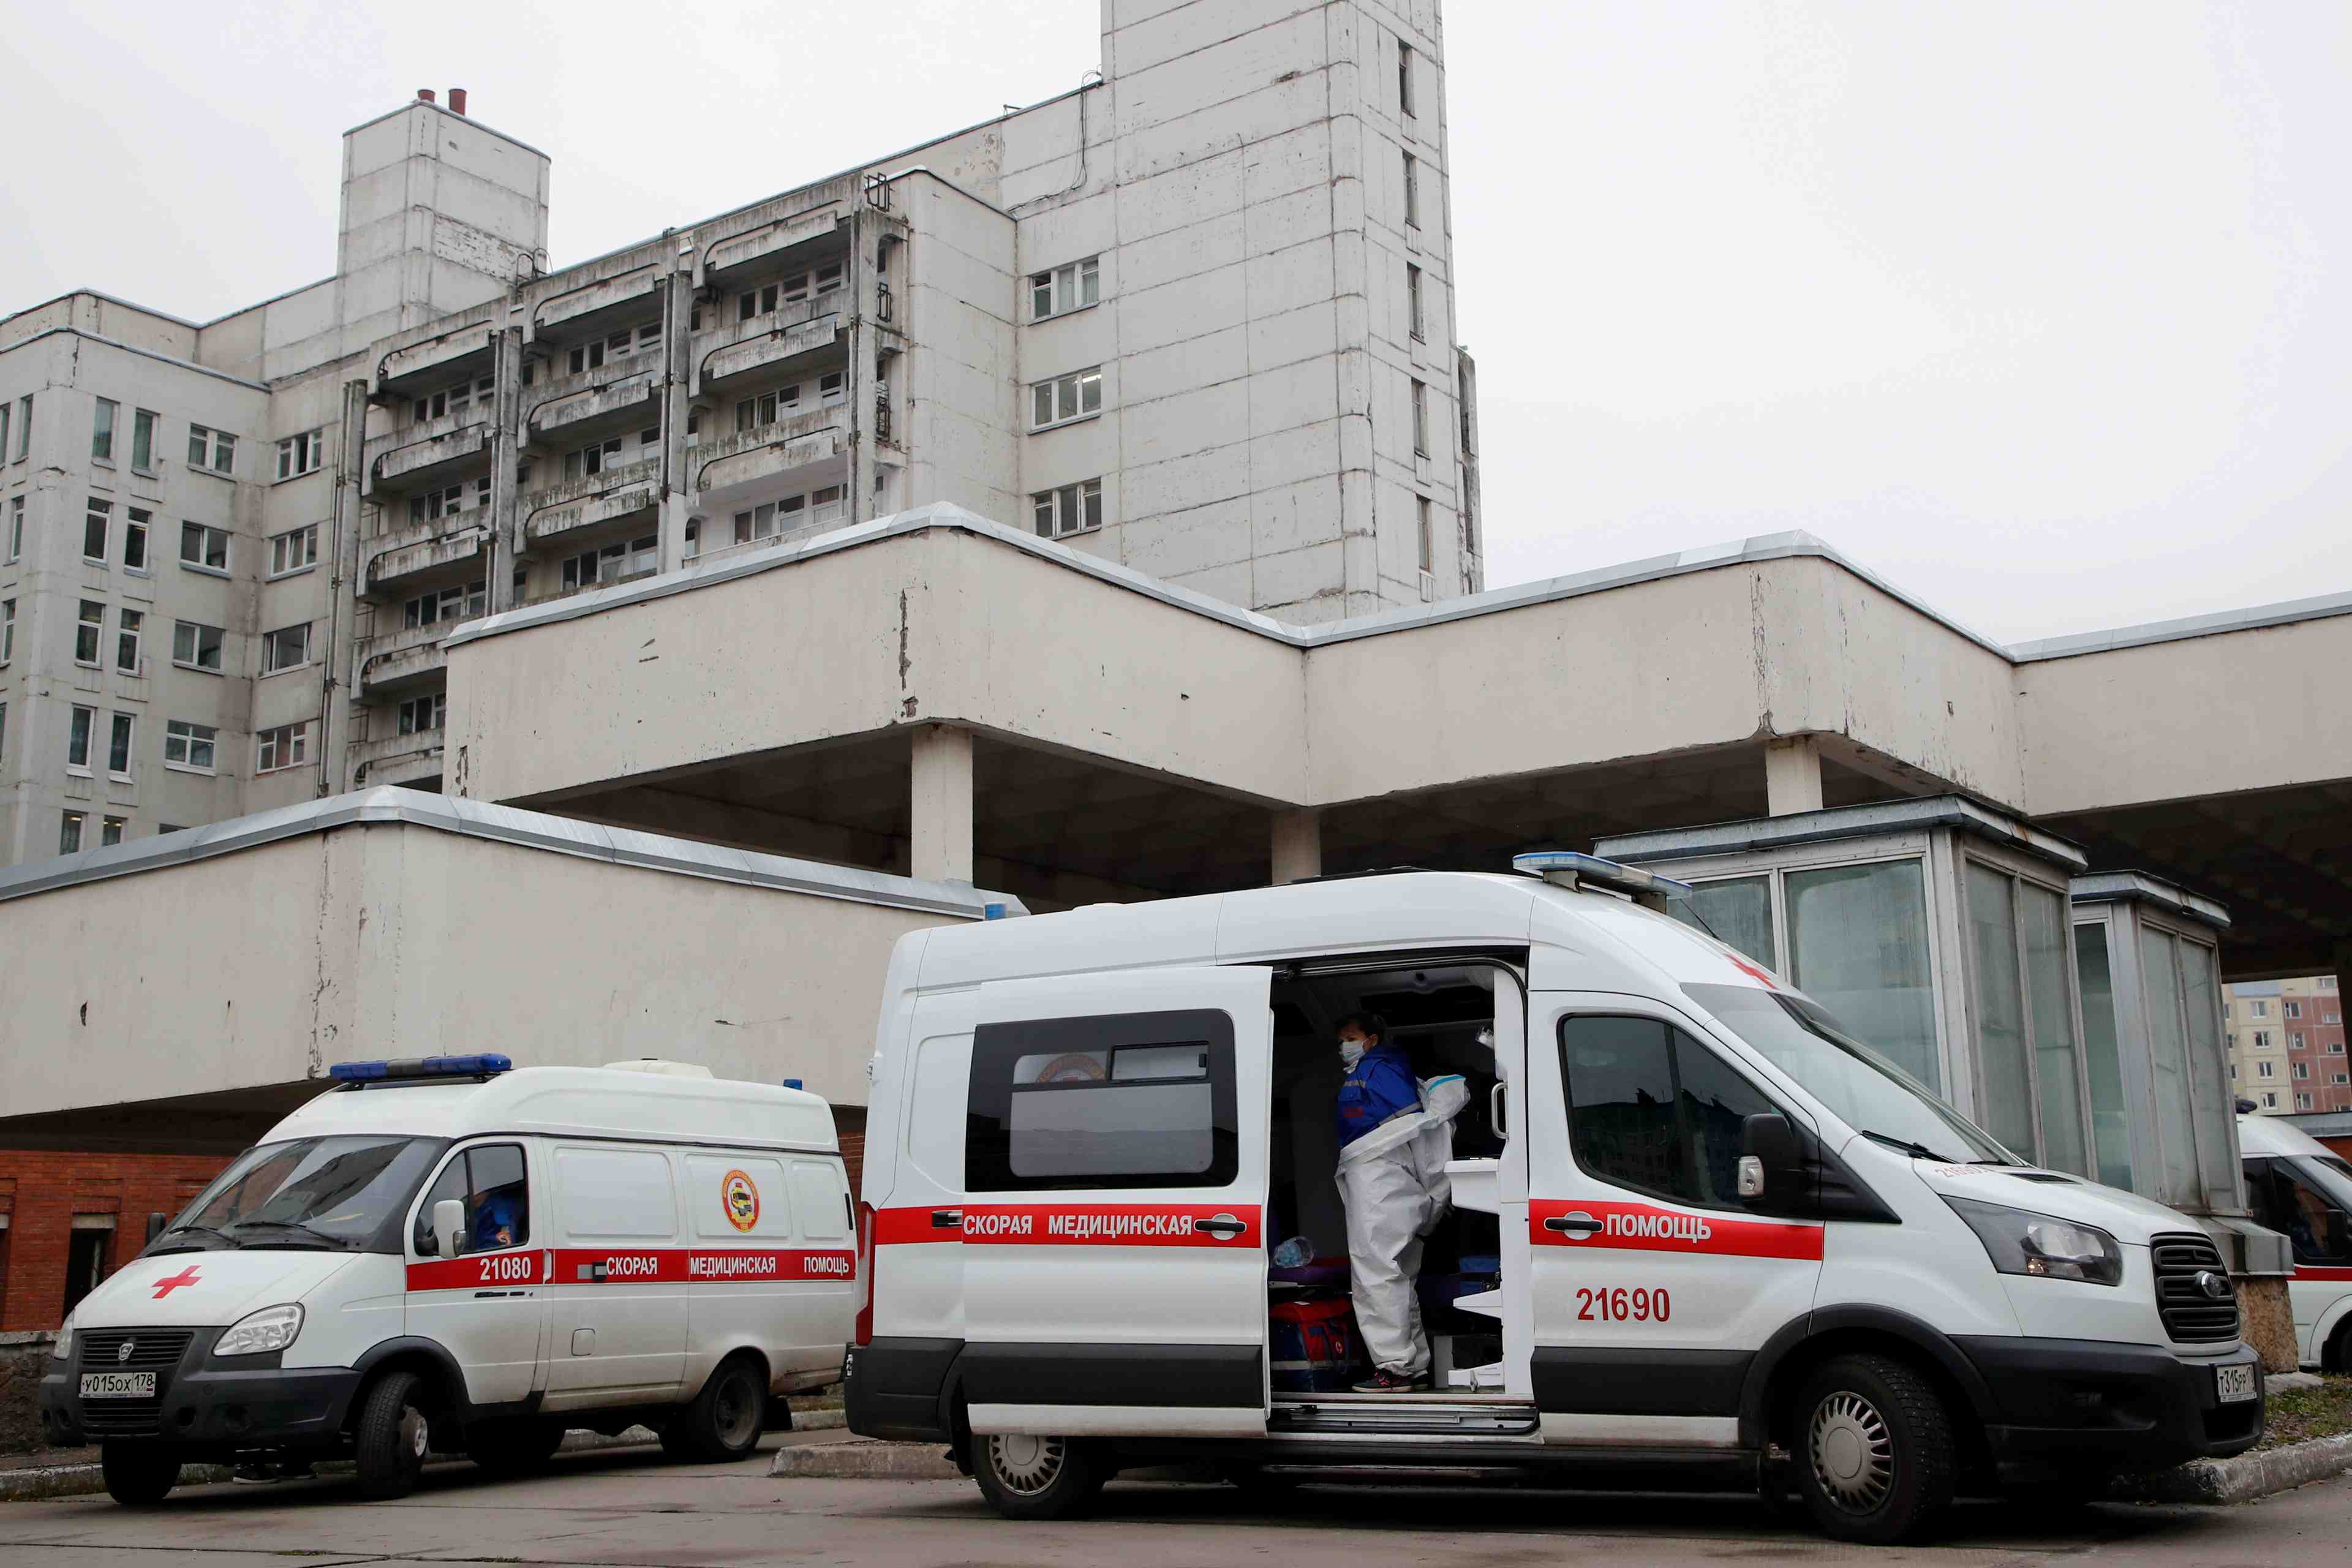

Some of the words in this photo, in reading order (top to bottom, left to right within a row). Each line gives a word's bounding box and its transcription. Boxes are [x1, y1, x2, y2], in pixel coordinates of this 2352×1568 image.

[963, 1215, 1033, 1235] СКОРАЯ
[1049, 1215, 1193, 1238] МЕДИЦИНСКАЯ
[1607, 1214, 1712, 1244] ПОМОЩЬ
[480, 1256, 531, 1280] 21080
[606, 1256, 657, 1275] СКОРАЯ
[690, 1257, 776, 1277] МЕДИЦИНСКАЯ
[804, 1257, 849, 1276] ПОМОЩЬ
[1576, 1287, 1671, 1322] 21690
[135, 1374, 153, 1386] 178
